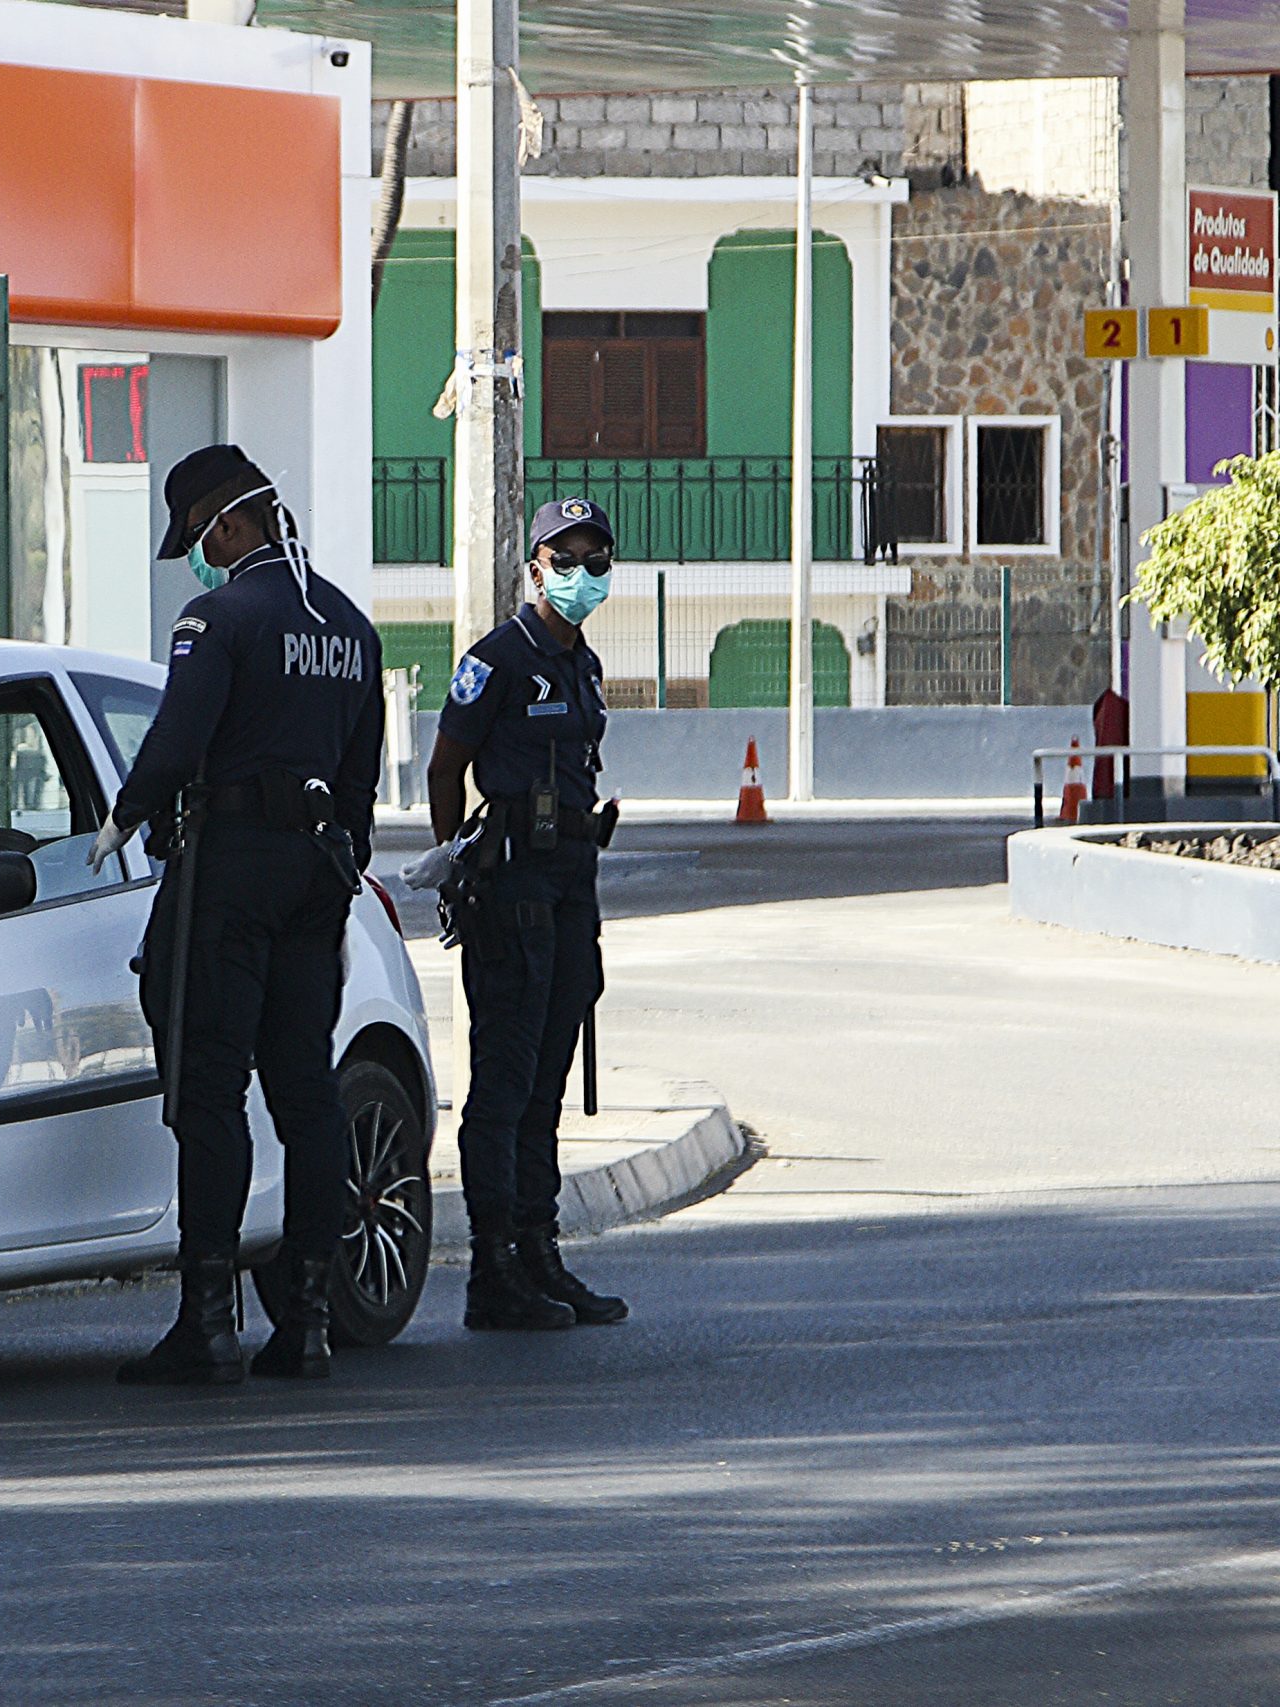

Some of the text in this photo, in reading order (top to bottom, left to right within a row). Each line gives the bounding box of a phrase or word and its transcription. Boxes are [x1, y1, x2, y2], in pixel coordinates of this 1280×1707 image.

[1194, 207, 1246, 237] Produtos
[1194, 243, 1270, 278] de Qualidade
[1103, 319, 1121, 348] 2
[1170, 318, 1181, 345] 1
[284, 633, 362, 682] POLICIA
